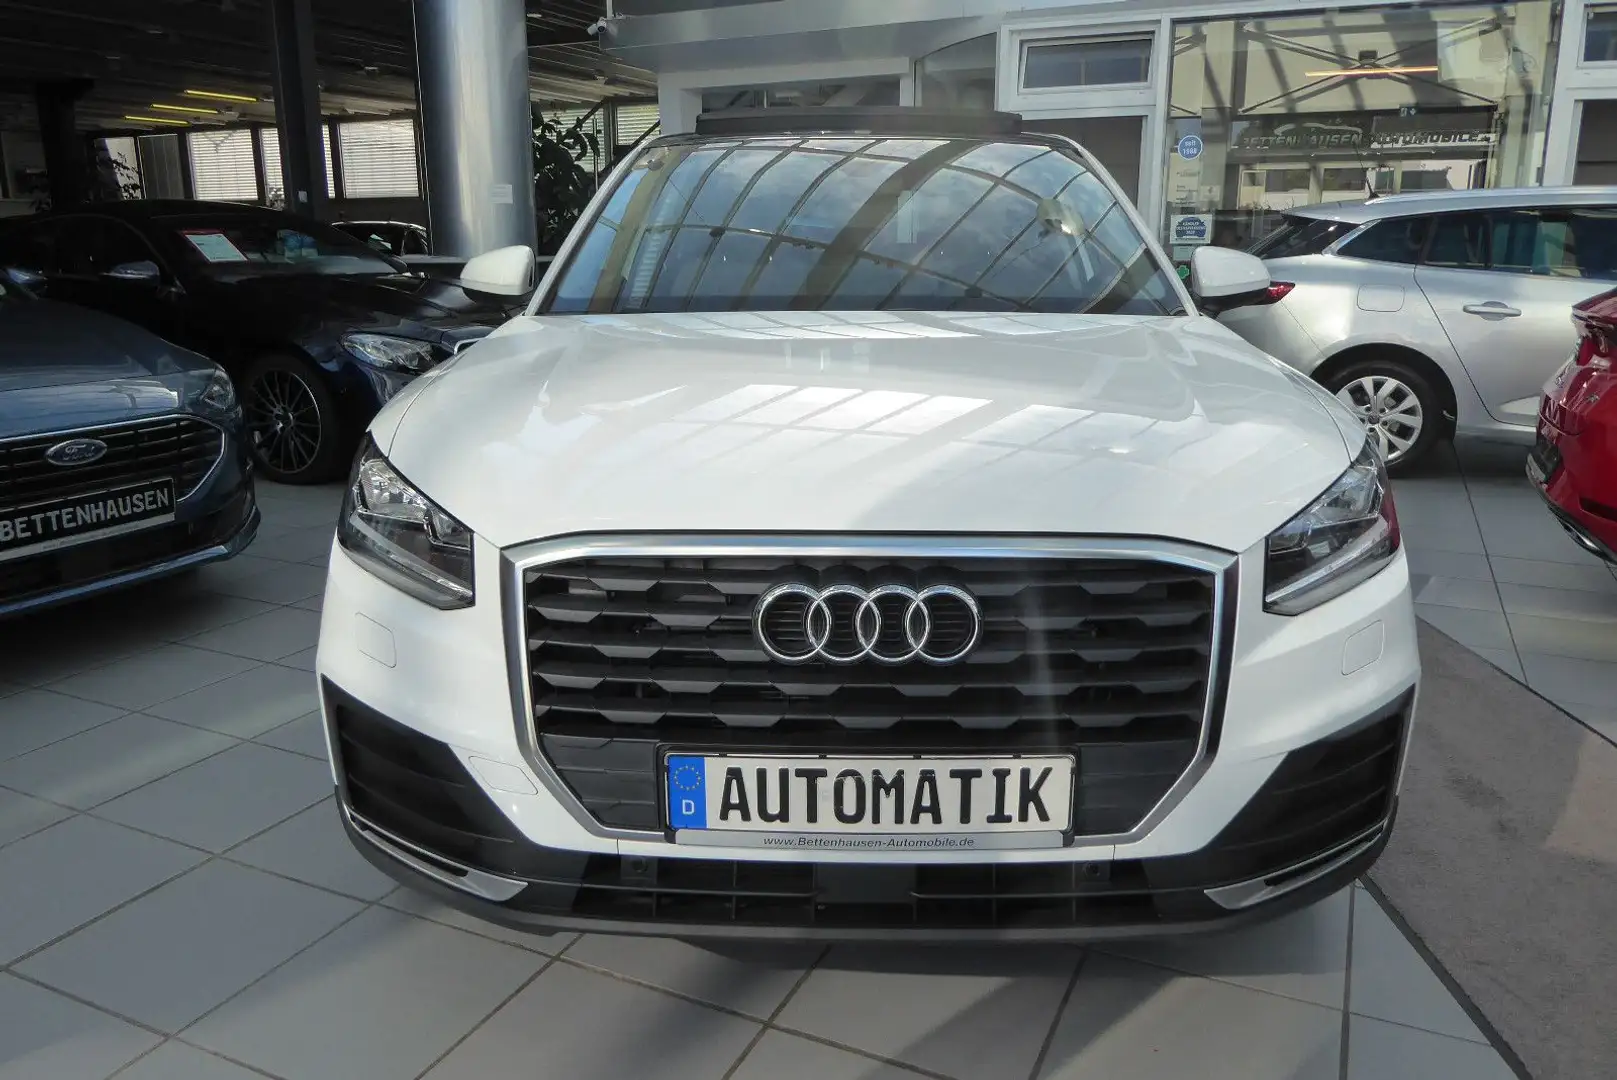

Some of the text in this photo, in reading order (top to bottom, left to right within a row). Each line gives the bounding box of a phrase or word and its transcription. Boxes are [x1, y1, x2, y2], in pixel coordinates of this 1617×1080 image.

[63, 444, 95, 461] Ford
[0, 487, 170, 542] BETTENHAUSEN
[719, 765, 1052, 826] AUTOMATIK
[682, 799, 695, 815] D
[763, 836, 975, 848] www.Bettenhausen-Automobile.de
